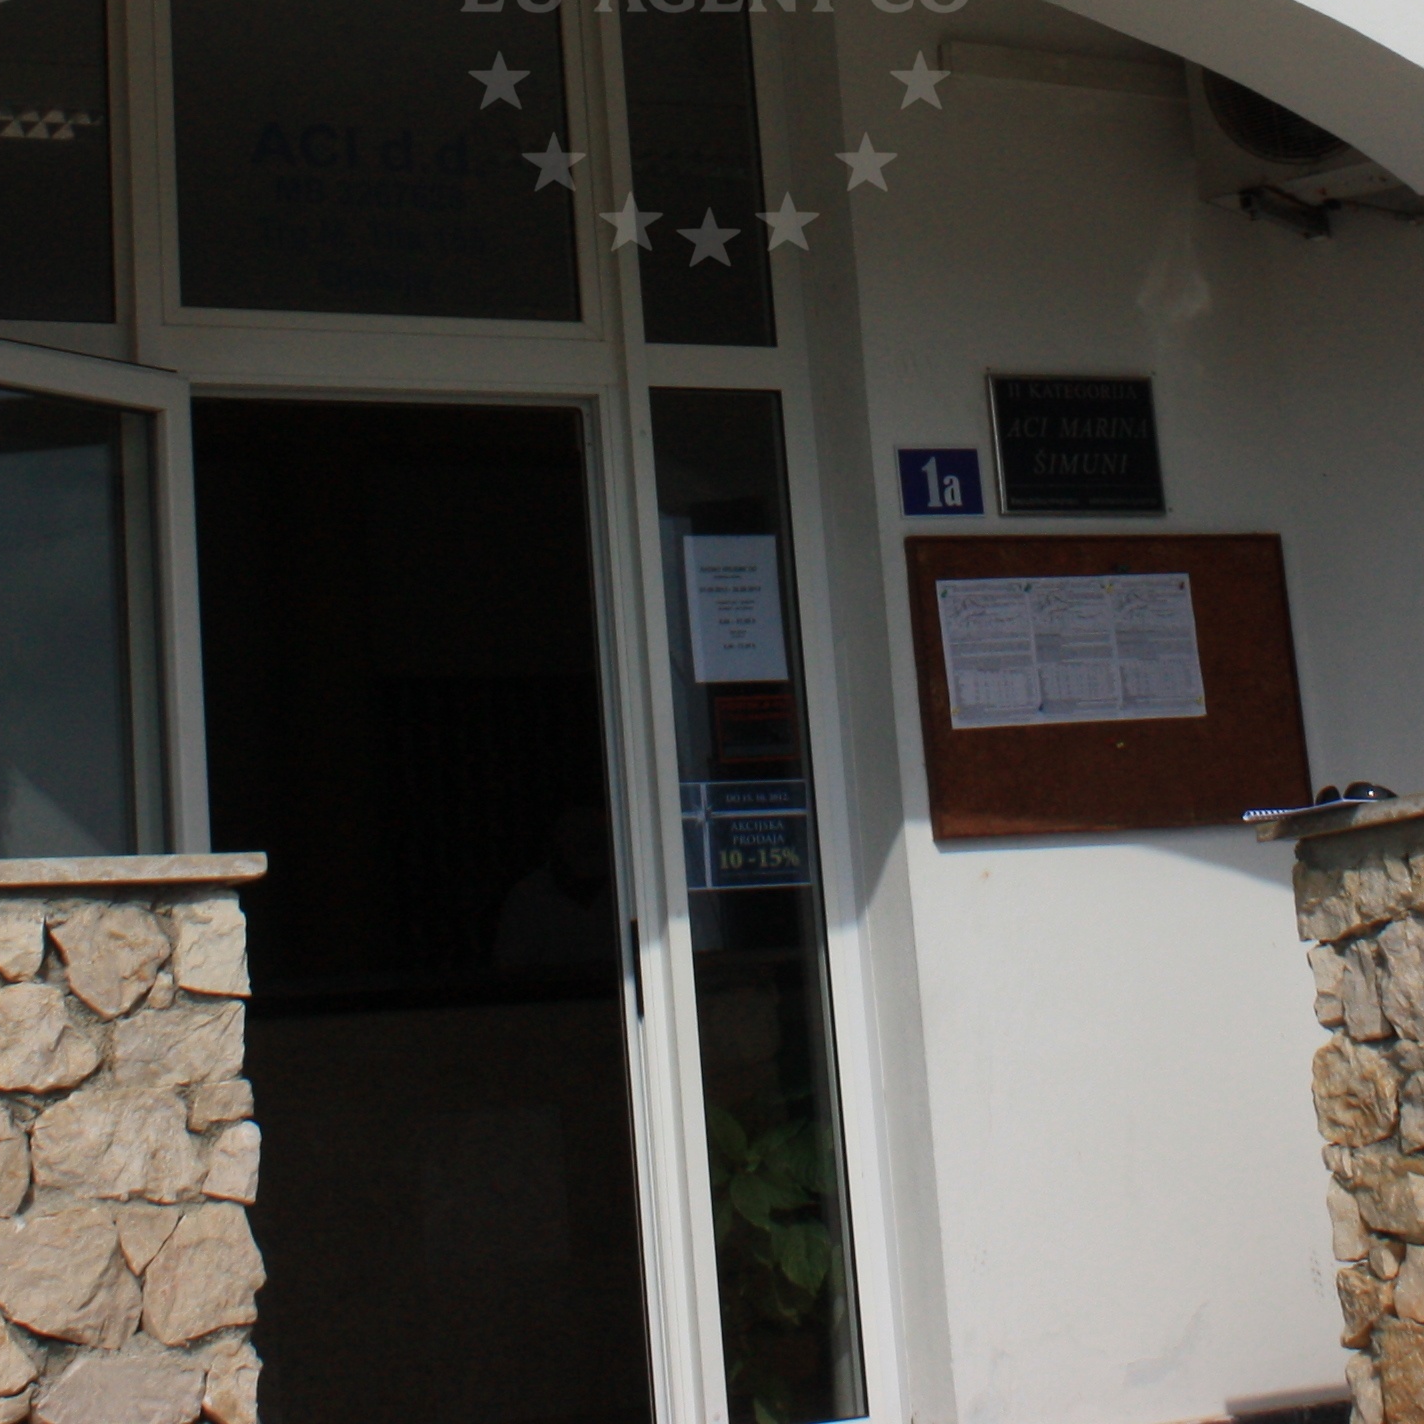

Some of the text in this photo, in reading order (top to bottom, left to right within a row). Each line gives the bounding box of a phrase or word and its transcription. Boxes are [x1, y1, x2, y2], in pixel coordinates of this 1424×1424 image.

[1006, 416, 1148, 439] ACI MARINA
[1033, 448, 1128, 475] ŠIMUNI
[921, 456, 963, 509] 1a
